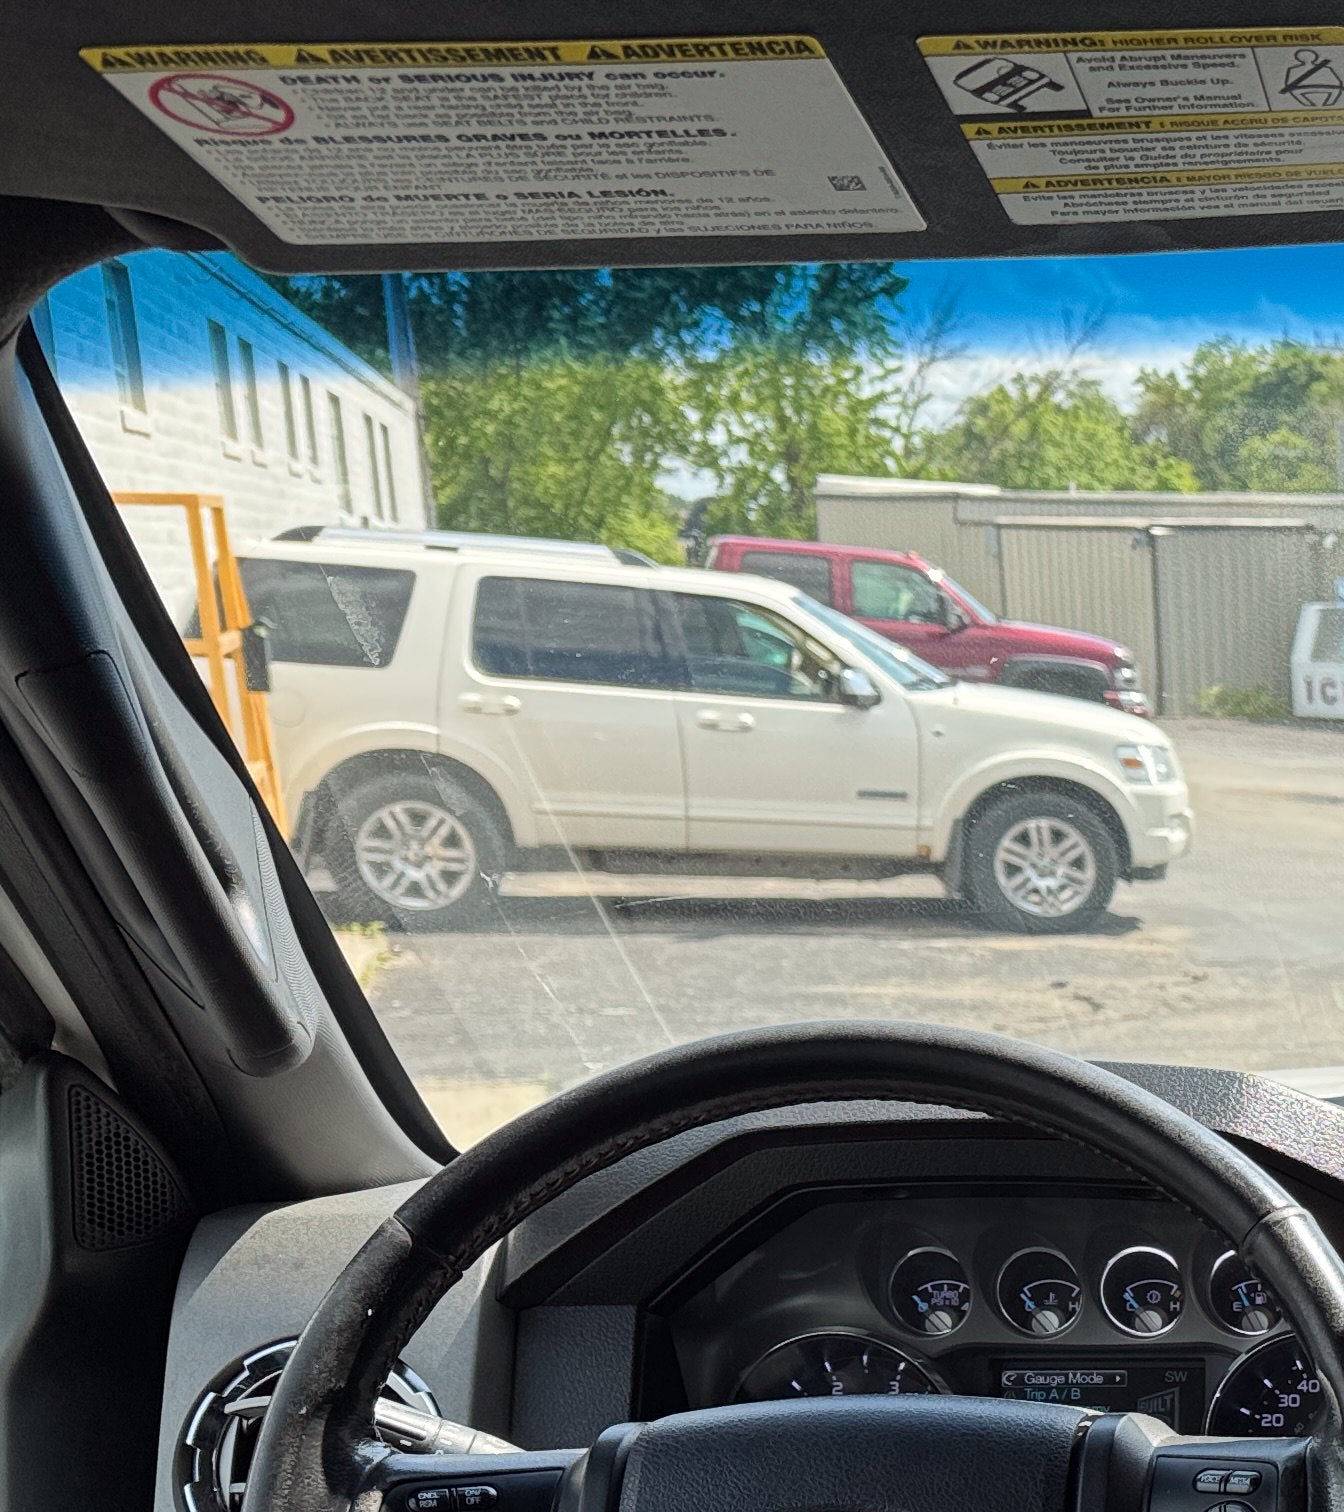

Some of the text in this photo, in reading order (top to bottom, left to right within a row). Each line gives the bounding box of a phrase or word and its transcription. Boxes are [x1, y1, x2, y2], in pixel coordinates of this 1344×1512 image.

[975, 33, 1323, 50] WARNING: HIGHER ROLLOVER RISK
[328, 46, 562, 66] AVERTISSEMENT
[622, 40, 815, 59] ADVERTENCIA
[126, 49, 272, 67] WARNING
[1076, 53, 1247, 64] Avoid Abrupt Maneuvers
[1089, 65, 1114, 73] and
[1119, 62, 1188, 72] Excessive
[280, 75, 361, 86] DEATH
[398, 73, 505, 84] SERIOUS
[510, 71, 595, 82] INJURY
[604, 71, 647, 80] can
[653, 70, 726, 80] occur.
[1106, 79, 1157, 89] Always
[1160, 78, 1207, 87] Buckle
[1105, 94, 1243, 105] See Owner's Manual
[1125, 104, 1174, 112] Further
[997, 120, 1152, 136] AVERTISSEMENT
[1168, 119, 1220, 129] RISQUE
[1223, 117, 1269, 126] ACCRU
[312, 135, 451, 146] BLESSURES
[456, 132, 548, 143] GRAVES
[554, 132, 582, 141] ou
[587, 128, 737, 141] MORTELLES.
[1043, 175, 1171, 189] ADVERTENCIA
[1186, 174, 1231, 184] MAYOR
[1233, 172, 1282, 182] RIESGO
[392, 192, 489, 202] MUERTE
[513, 190, 581, 201] SERIA
[586, 186, 675, 199] LESIÓN.
[1171, 1301, 1181, 1311] H
[1232, 1301, 1242, 1311] E
[1024, 1371, 1104, 1387] Gauge Mode
[1163, 1370, 1188, 1382] SW
[832, 1381, 845, 1395] 2
[889, 1381, 901, 1394] 3
[1297, 1379, 1321, 1393] 40
[1023, 1388, 1046, 1402] Trip
[1048, 1389, 1060, 1400] A
[1071, 1388, 1081, 1400] B
[1278, 1394, 1300, 1407] 30
[1261, 1413, 1285, 1427] 20
